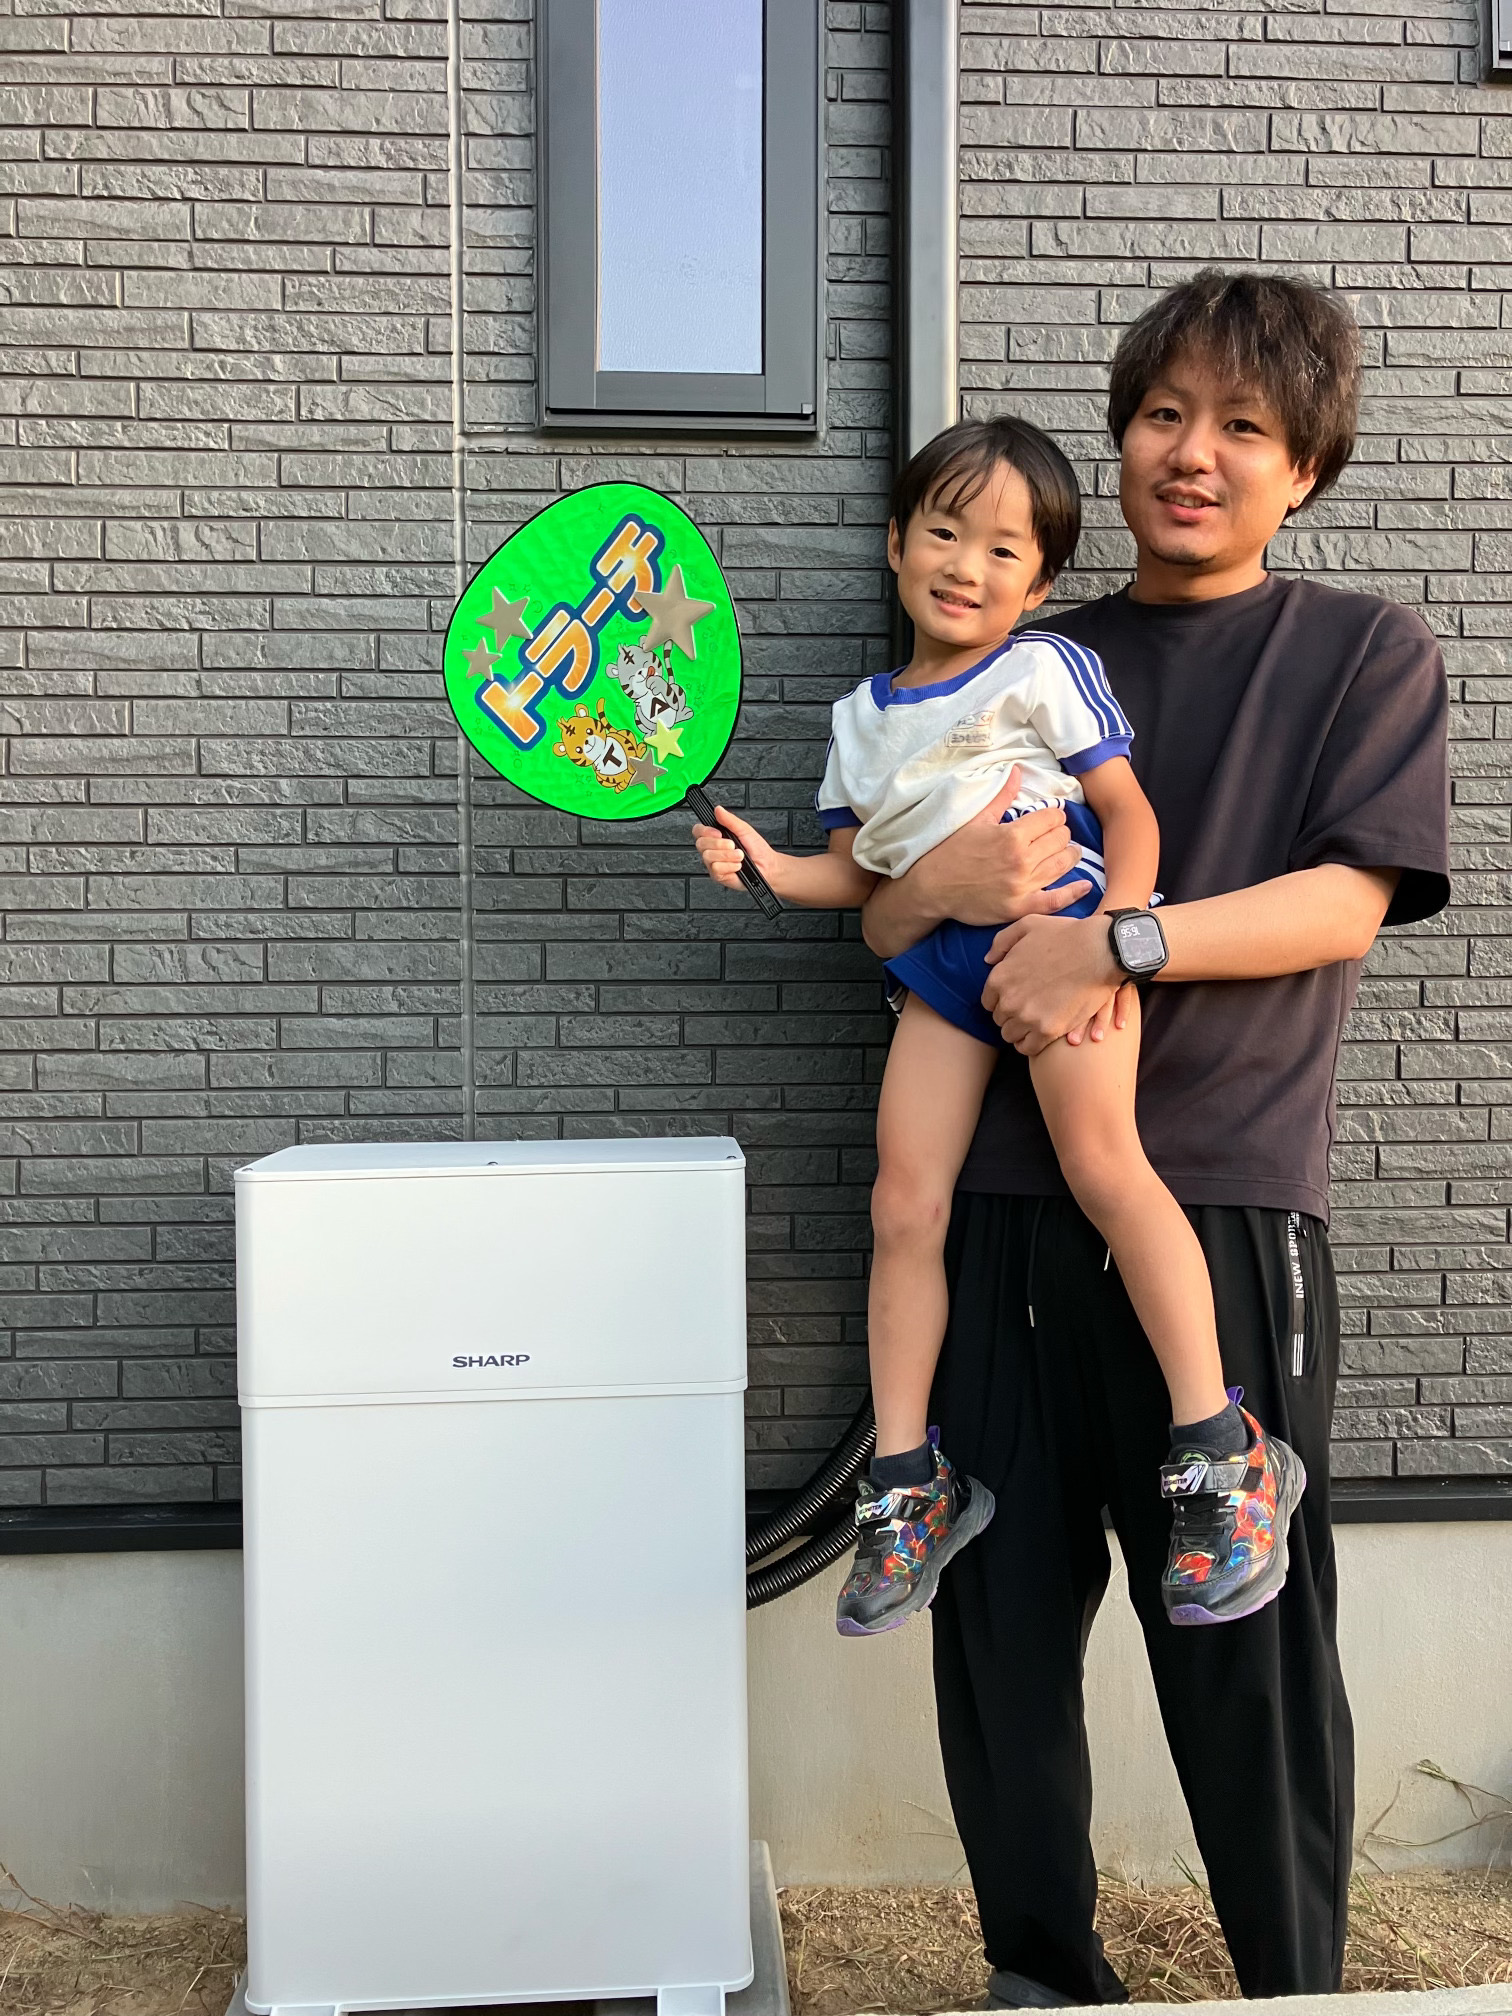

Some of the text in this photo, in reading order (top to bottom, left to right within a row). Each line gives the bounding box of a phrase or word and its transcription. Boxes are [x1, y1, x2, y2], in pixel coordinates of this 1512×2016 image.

[479, 518, 661, 746] トラーチ
[649, 696, 672, 721] A
[602, 745, 624, 768] T
[452, 1354, 531, 1368] SHARP
